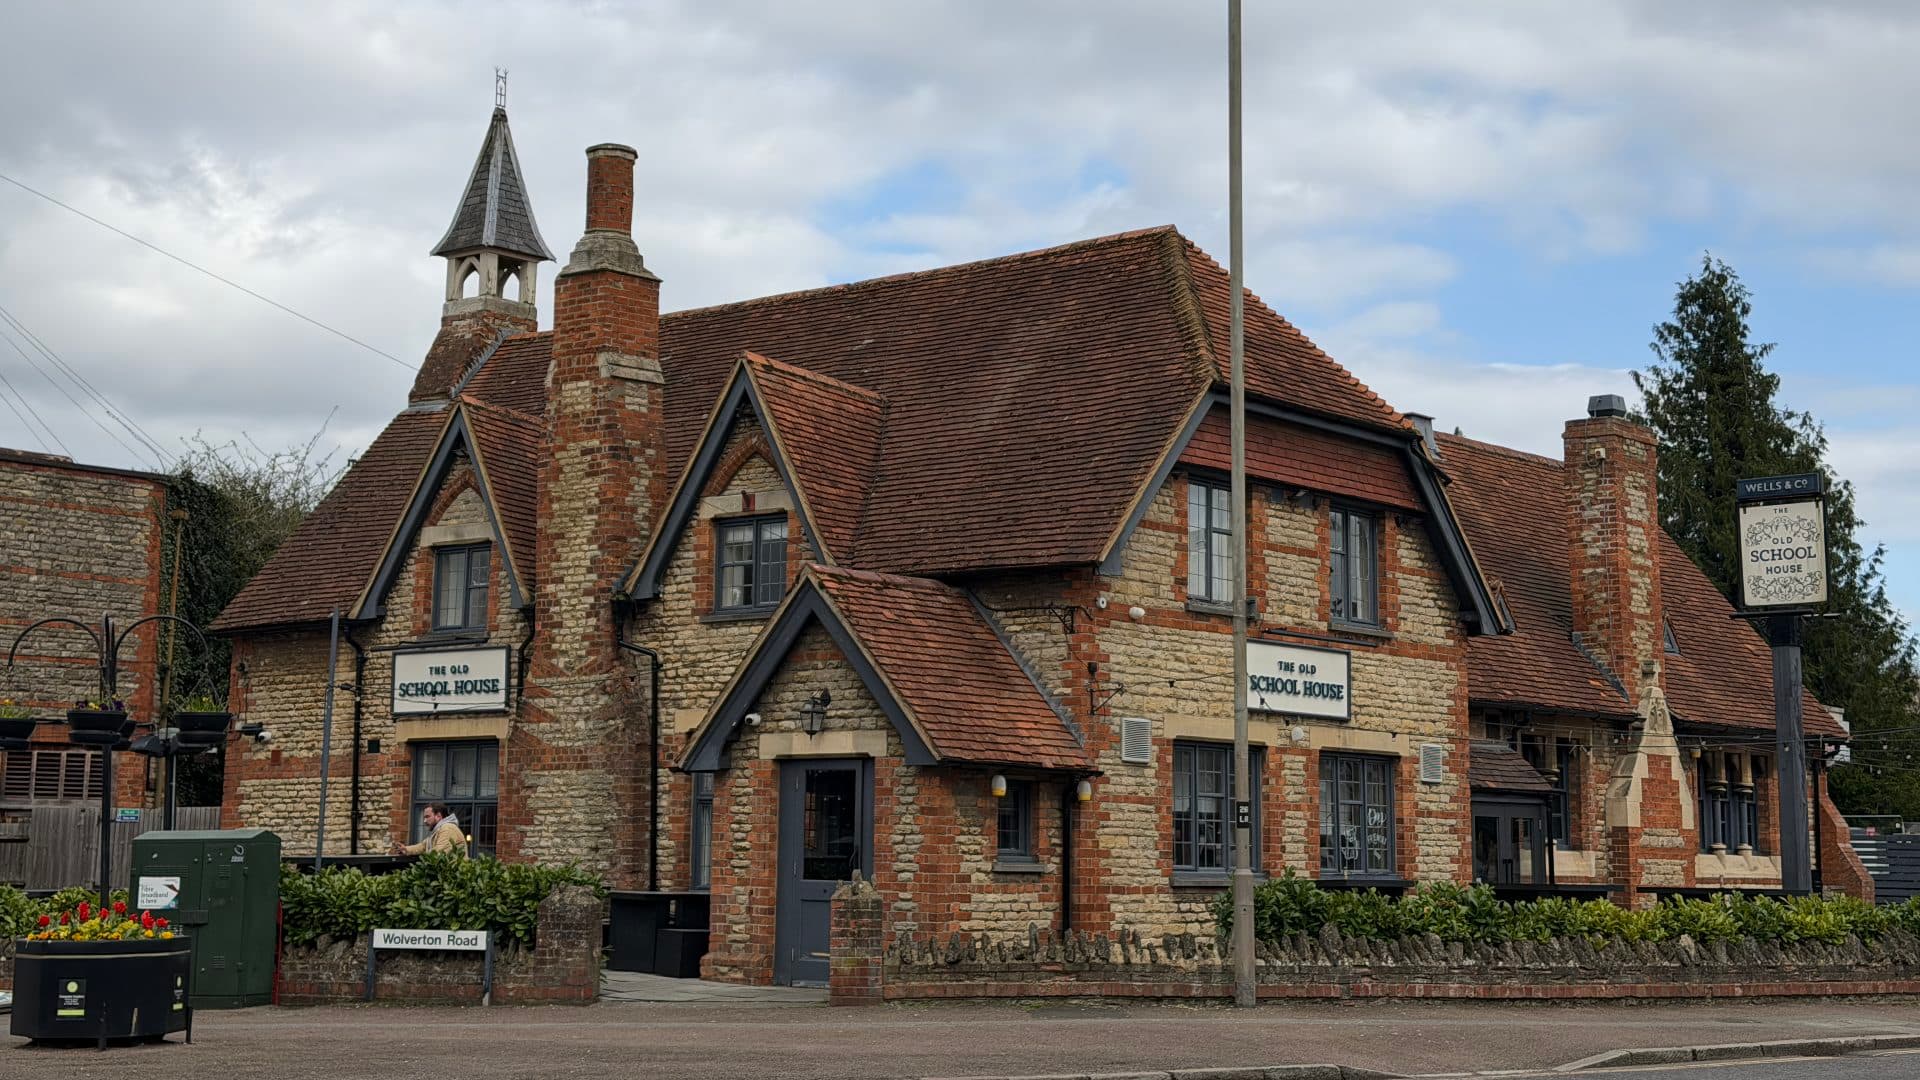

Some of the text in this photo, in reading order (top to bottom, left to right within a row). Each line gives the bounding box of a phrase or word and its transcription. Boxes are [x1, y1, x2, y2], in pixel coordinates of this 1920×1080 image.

[1745, 481, 1782, 493] WELLS
[1784, 480, 1792, 490] &
[1772, 537, 1793, 545] OLD
[1750, 546, 1817, 563] SCHOOL
[1765, 564, 1803, 575] HOUSE
[428, 664, 469, 676] THE OLD
[1278, 661, 1317, 675] THE OLD
[398, 678, 500, 698] SCHOOL HOUSE
[1249, 674, 1344, 700] SCHOOL HOUSE
[383, 933, 478, 946] Wolverton Road
